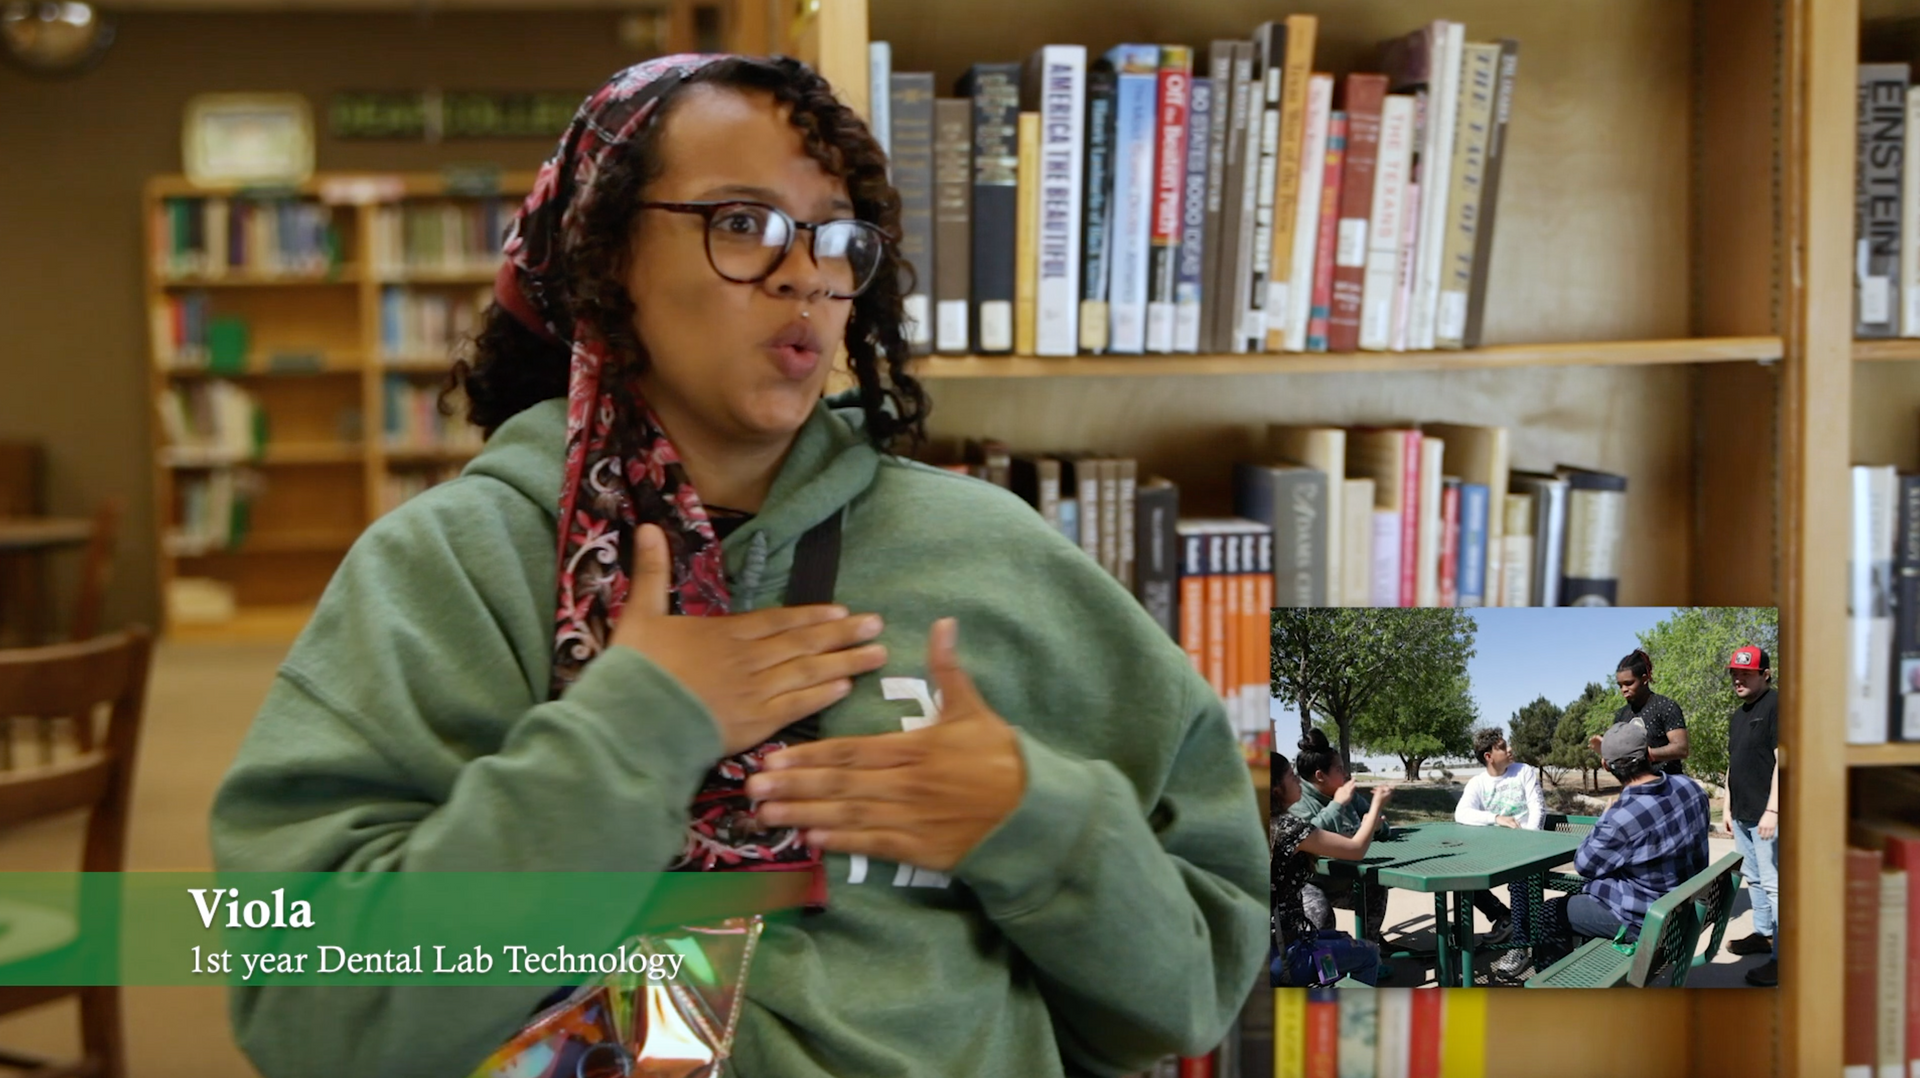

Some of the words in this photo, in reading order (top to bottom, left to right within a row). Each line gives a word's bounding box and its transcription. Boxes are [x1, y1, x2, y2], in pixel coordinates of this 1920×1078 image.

[1047, 64, 1073, 144] AMERICA
[1164, 74, 1186, 107] Off
[1470, 52, 1493, 109] THE
[1129, 104, 1145, 141] Most
[1164, 108, 1176, 124] the
[1385, 113, 1406, 151] THE
[1159, 126, 1182, 187] Beaten
[1187, 113, 1208, 172] STATES
[1461, 122, 1487, 191] FACE
[1045, 151, 1070, 182] THE
[1871, 80, 1904, 256] EINSTEIN
[1157, 190, 1180, 234] Path
[1378, 161, 1402, 238] TEXANS
[1458, 200, 1478, 240] OF
[1041, 188, 1069, 280] BEAUTIFUL
[1181, 227, 1203, 274] IDEAS
[1453, 251, 1473, 291] TE
